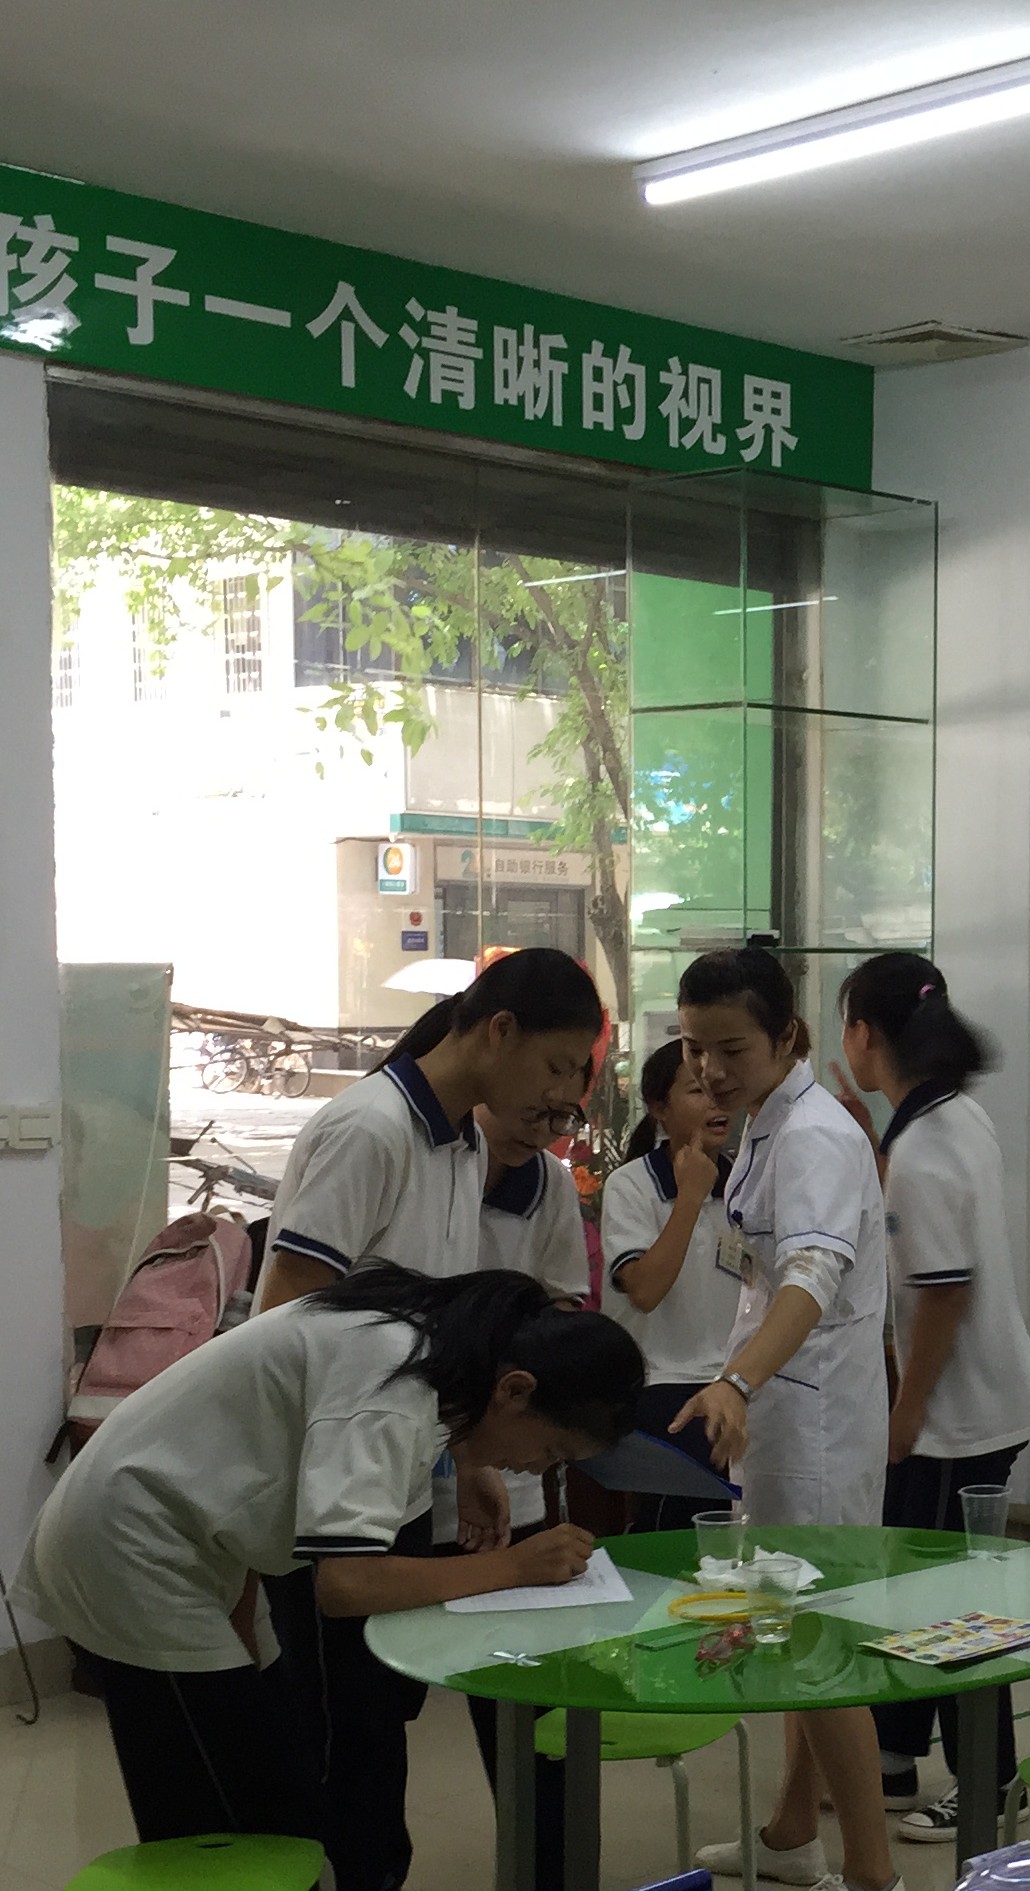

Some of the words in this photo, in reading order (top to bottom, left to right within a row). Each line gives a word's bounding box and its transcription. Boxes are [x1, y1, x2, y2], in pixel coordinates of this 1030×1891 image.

[0, 213, 800, 468] 孩子一个清晰的视界
[495, 858, 569, 876] 自助银行服务
